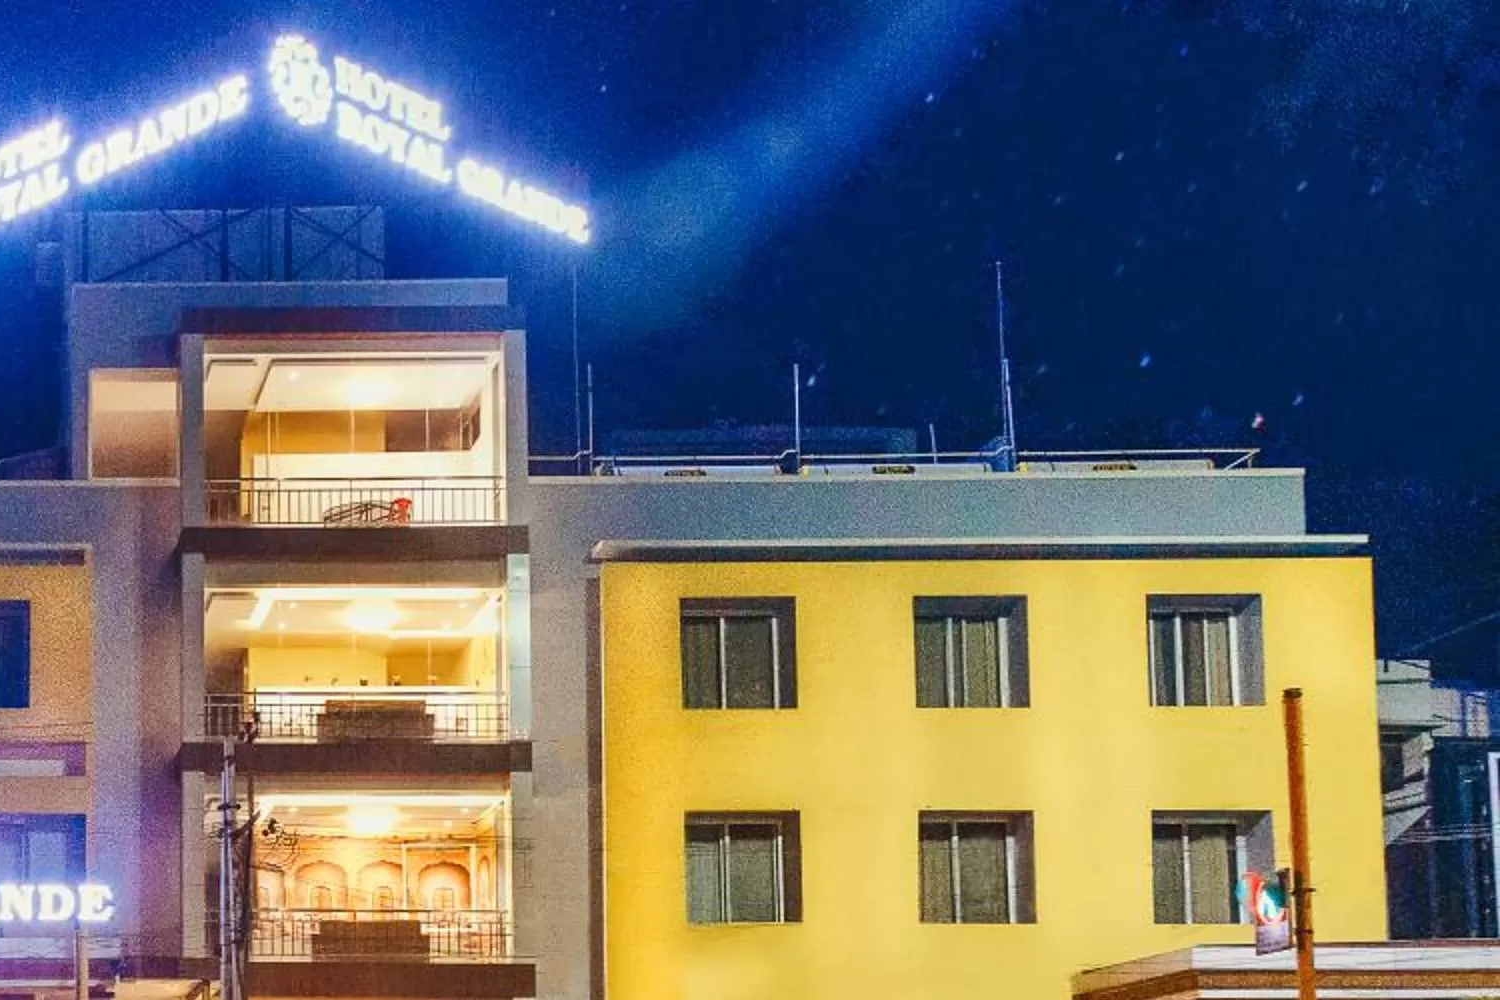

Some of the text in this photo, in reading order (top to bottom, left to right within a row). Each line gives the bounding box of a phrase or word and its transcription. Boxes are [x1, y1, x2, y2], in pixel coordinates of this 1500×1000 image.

[77, 76, 247, 183] GRANDE
[333, 56, 451, 142] HOTEL
[337, 101, 589, 243] ROYAL GRANDE
